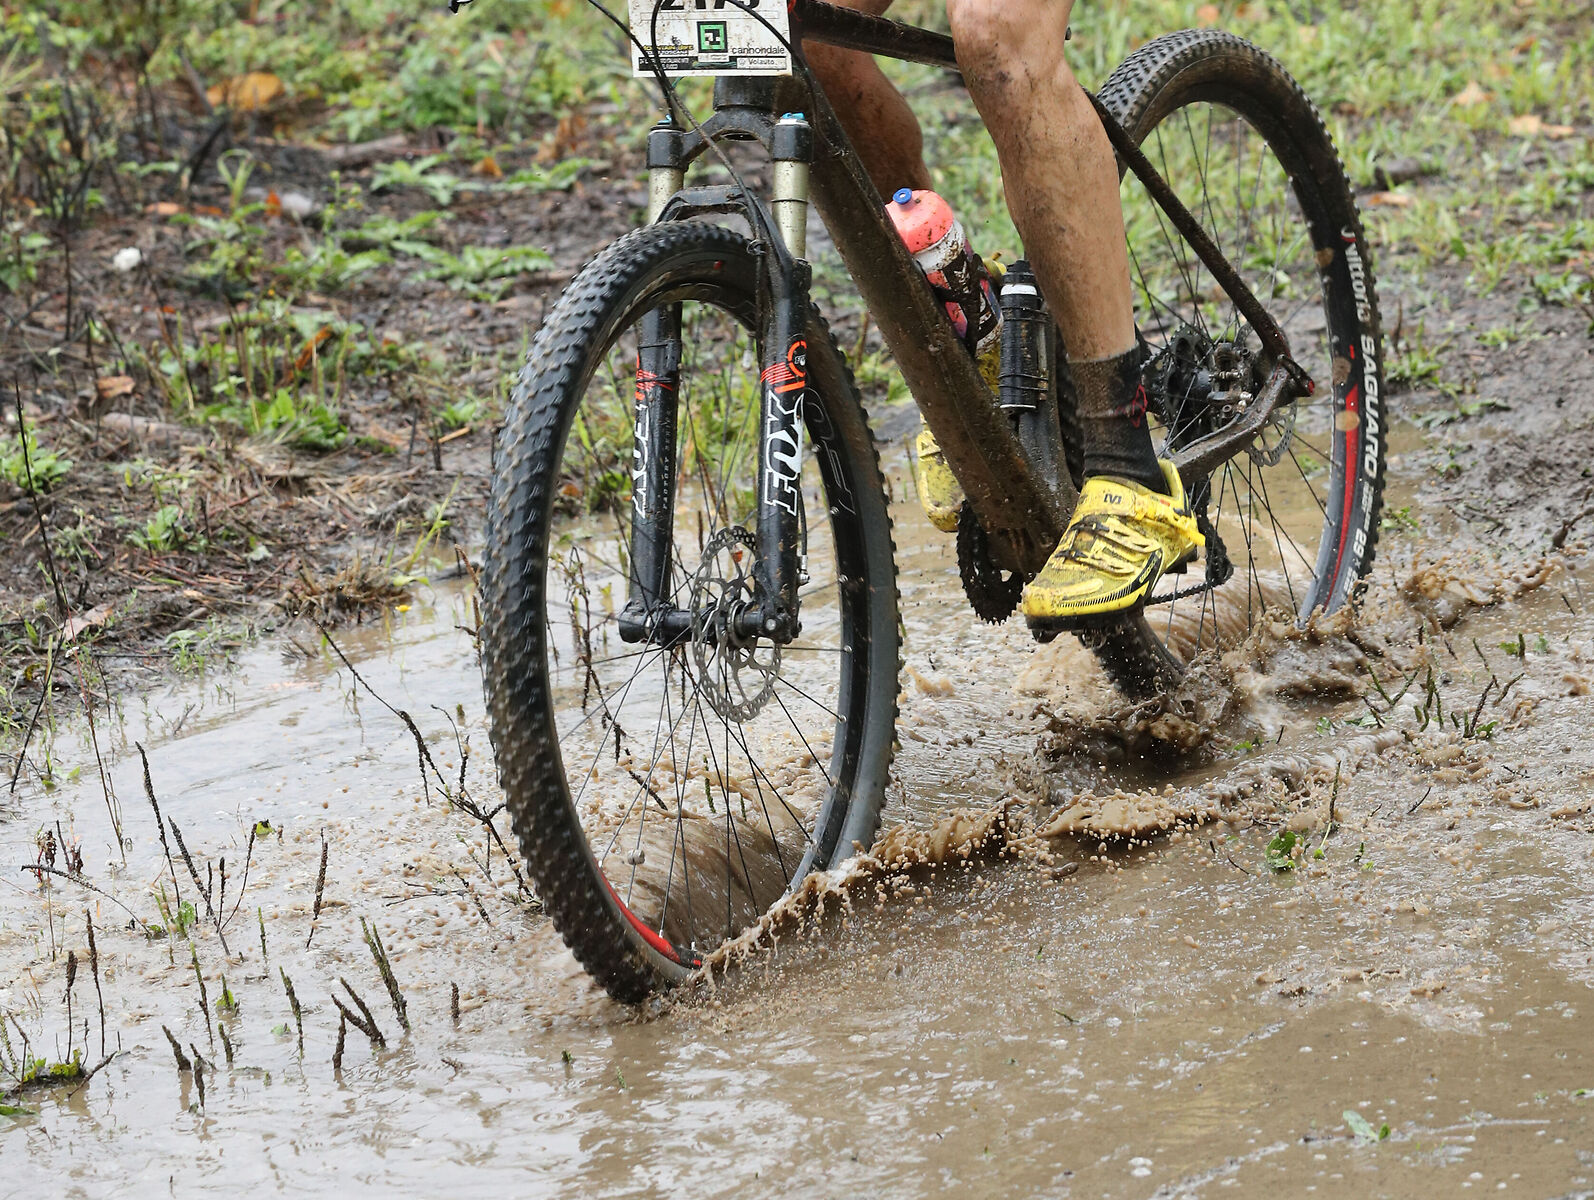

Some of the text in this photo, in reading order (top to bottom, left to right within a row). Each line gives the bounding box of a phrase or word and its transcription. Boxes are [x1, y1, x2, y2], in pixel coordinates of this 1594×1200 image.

[732, 45, 785, 55] cannondale
[764, 389, 805, 517] FOX
[1360, 334, 1379, 480] SAGUARO
